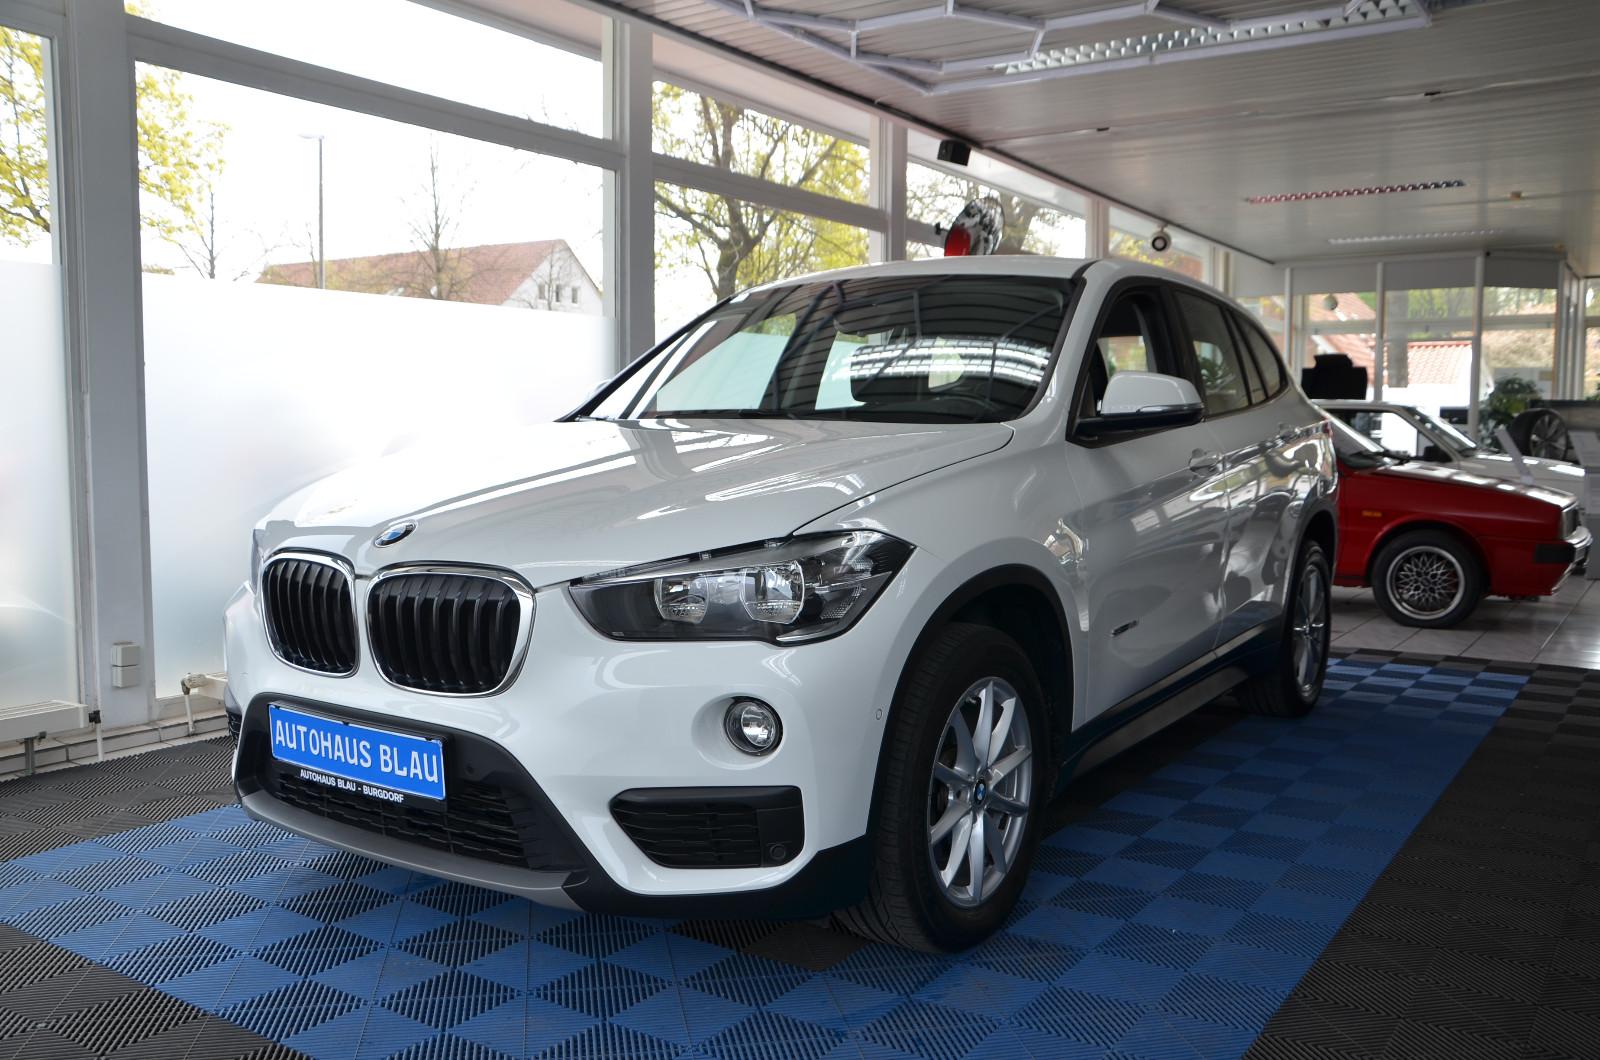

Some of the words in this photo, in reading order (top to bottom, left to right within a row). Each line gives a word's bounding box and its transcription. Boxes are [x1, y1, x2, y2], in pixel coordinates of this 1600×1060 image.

[275, 719, 372, 768] AUTOHAUS
[379, 744, 439, 784] BLAU
[300, 769, 336, 786] AUTOHAUS
[337, 778, 356, 792] BLAU
[363, 785, 405, 803] BURGDORF
